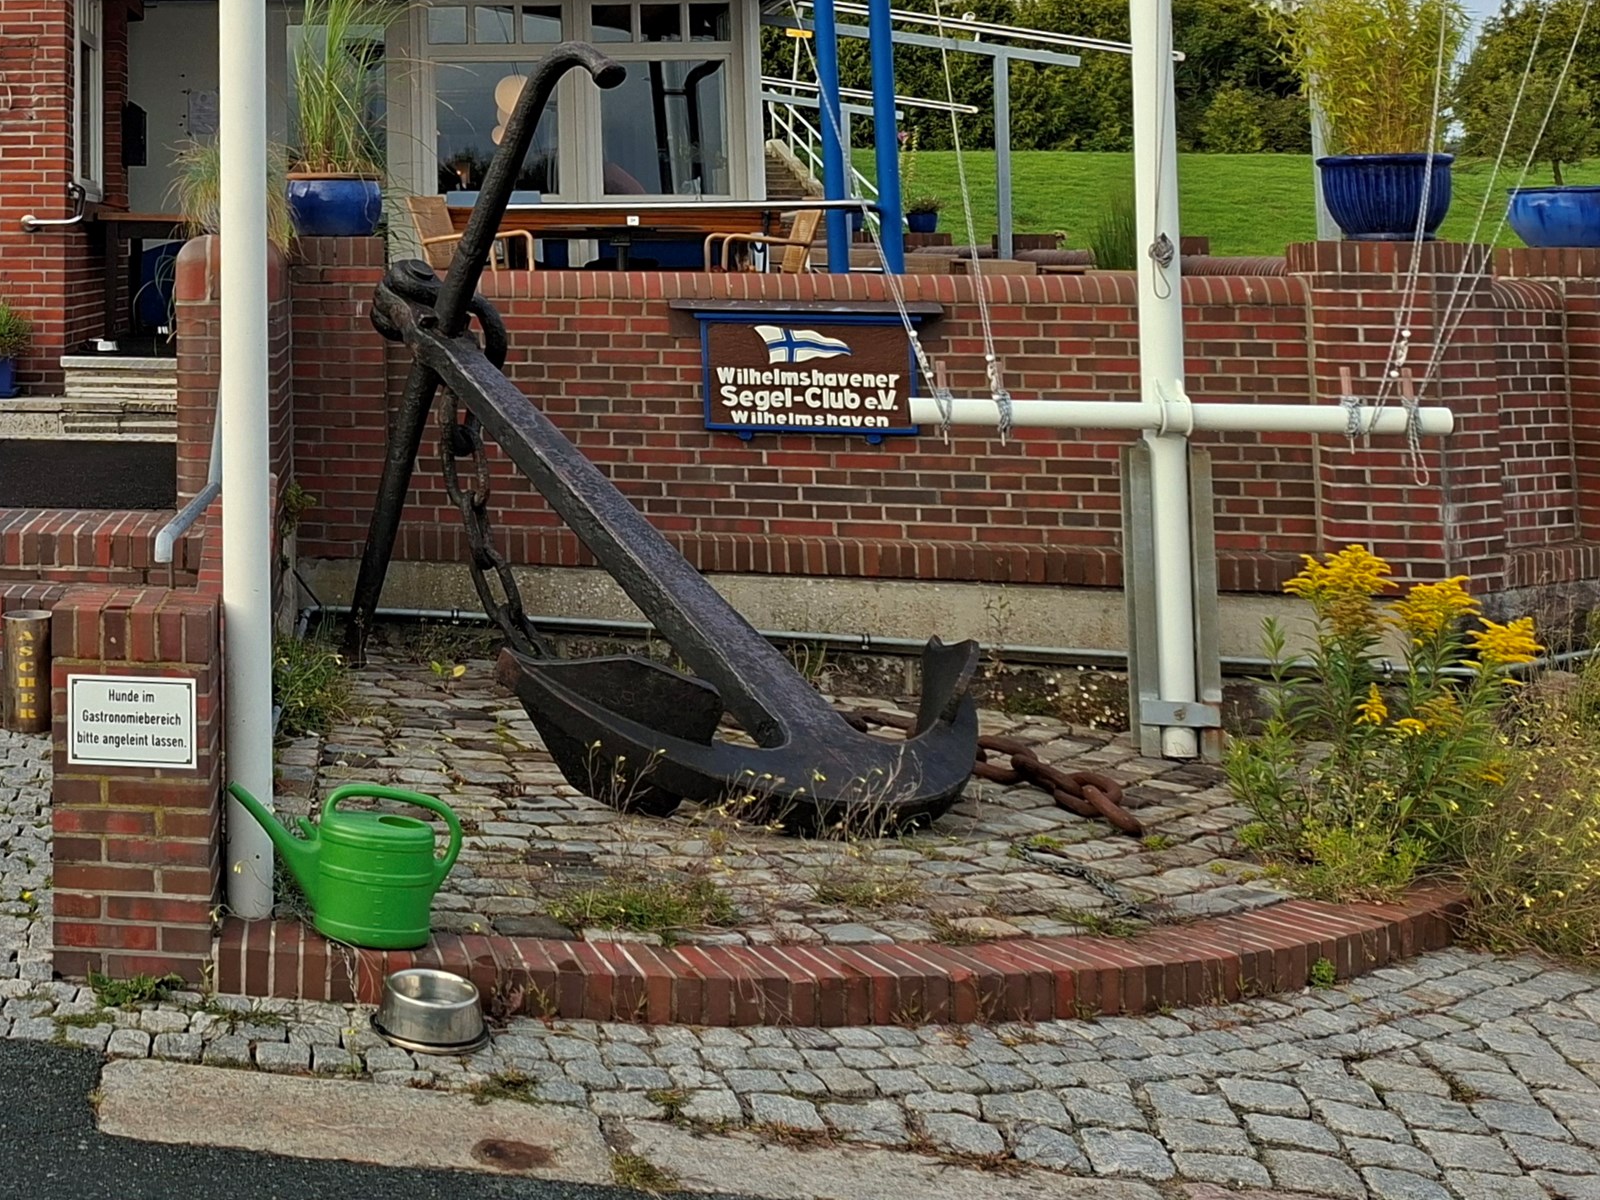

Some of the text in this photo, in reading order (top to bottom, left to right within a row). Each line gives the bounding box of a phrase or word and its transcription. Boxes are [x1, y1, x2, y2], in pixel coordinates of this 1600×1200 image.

[716, 367, 900, 388] Wilhelmshavener
[720, 386, 899, 411] Segel-Club e.V.
[730, 410, 890, 427] Wilhelmshaven
[17, 630, 37, 719] ASCHER
[108, 689, 155, 703] Hunde im
[82, 709, 182, 726] Gastronomiebereich
[76, 731, 187, 748] bitte angeleint lassen.
